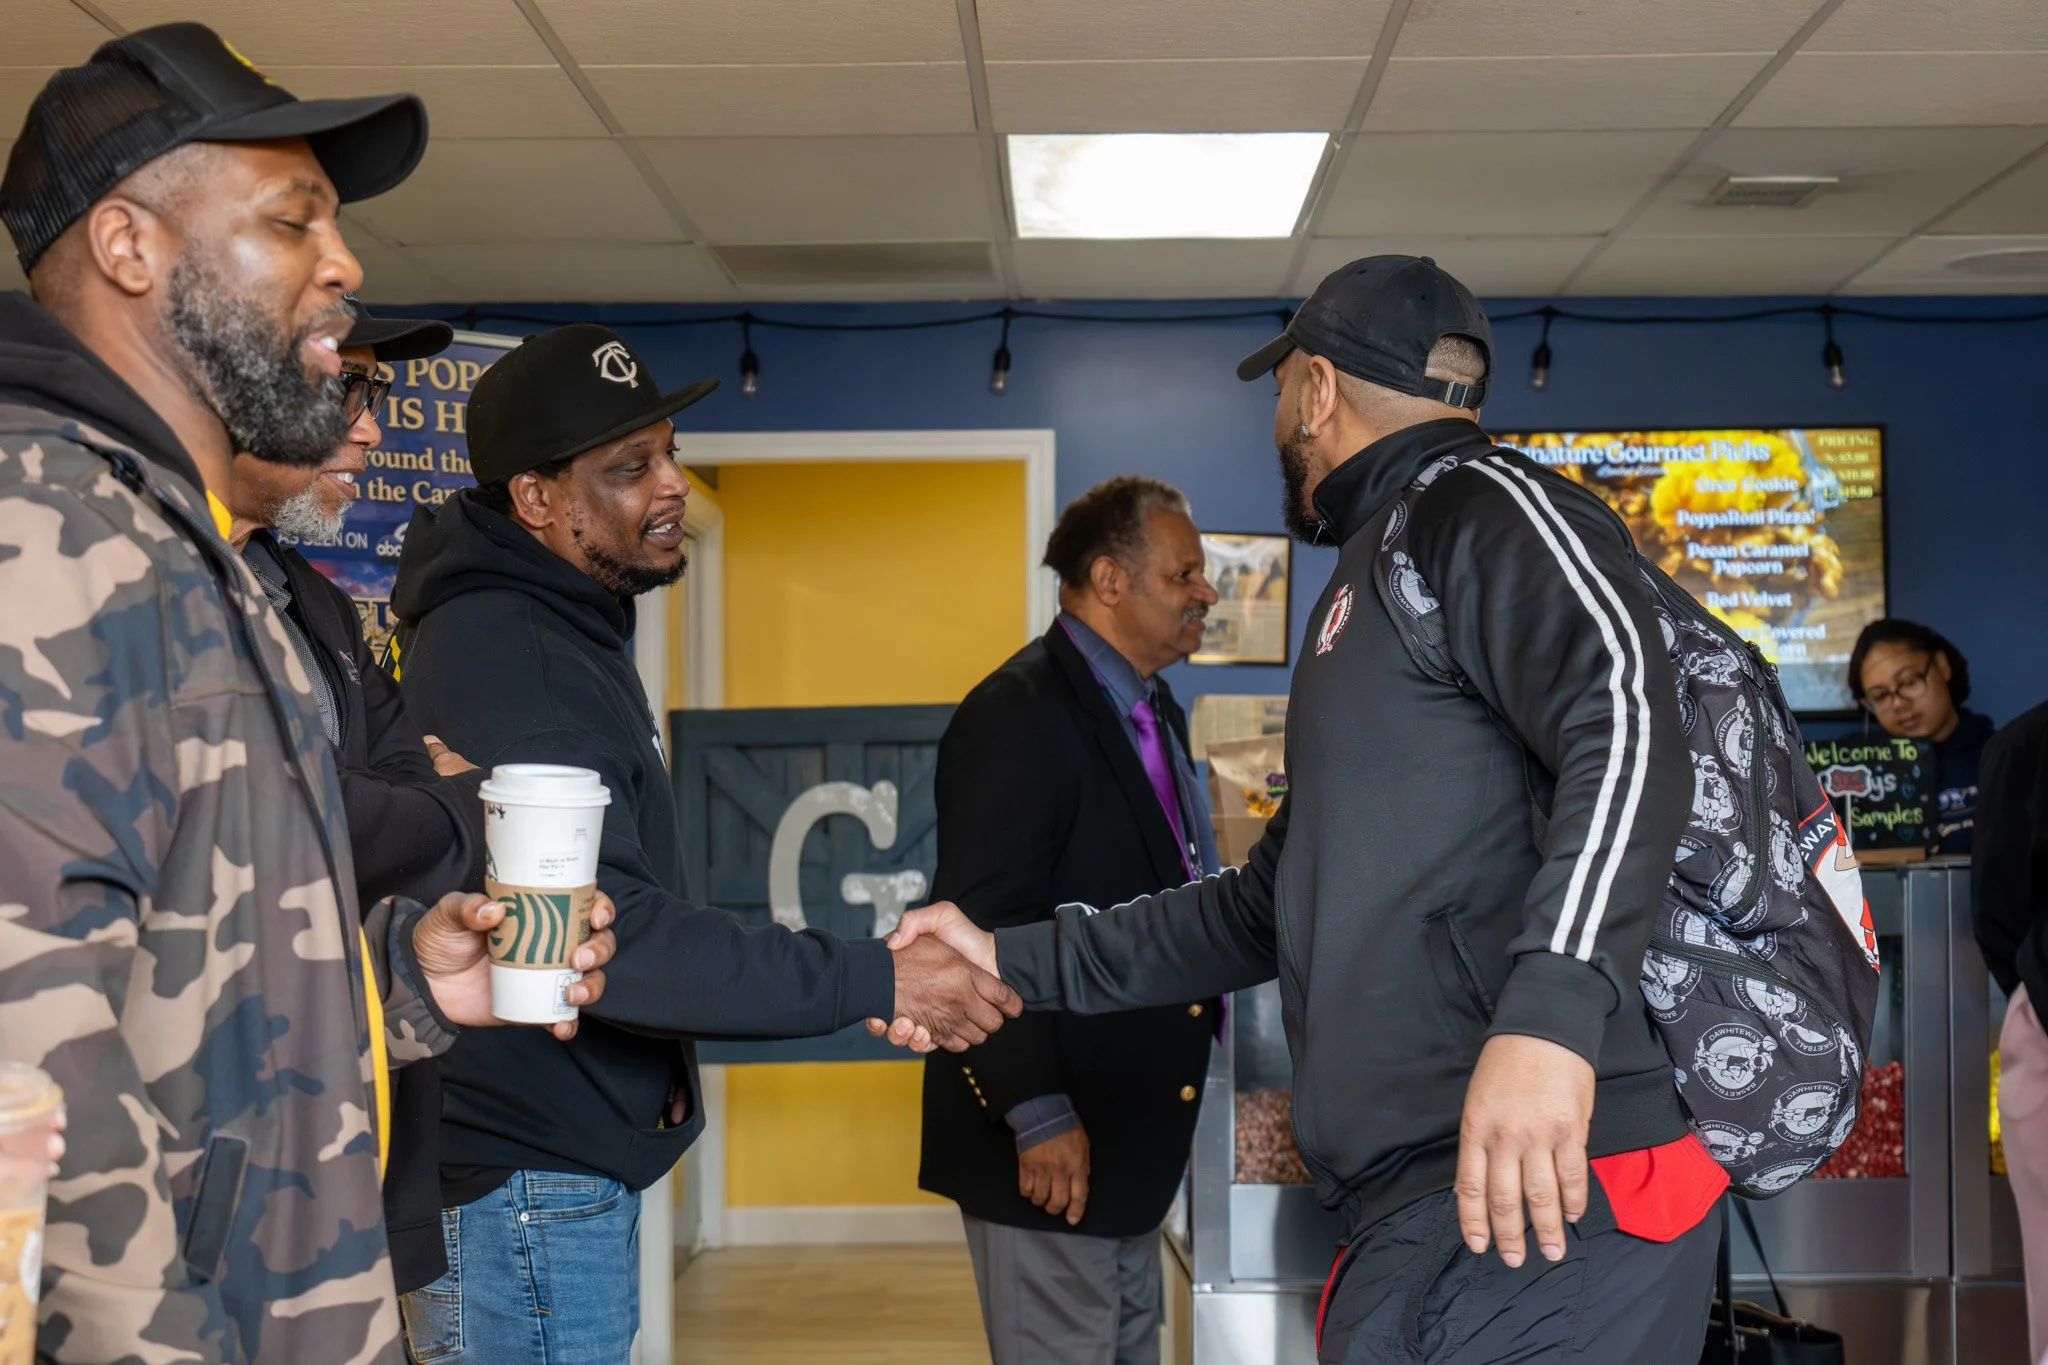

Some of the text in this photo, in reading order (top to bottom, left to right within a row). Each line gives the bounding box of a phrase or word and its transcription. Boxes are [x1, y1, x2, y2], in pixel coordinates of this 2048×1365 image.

[405, 358, 494, 392] POP
[386, 396, 425, 430] IS
[1605, 441, 1706, 464] Gourmet
[1710, 440, 1770, 461] Picks
[368, 476, 407, 499] the
[1741, 475, 1799, 492] Cookie
[346, 531, 368, 549] ON
[1687, 541, 1810, 559] Pecan Caramel
[1713, 558, 1785, 578] Popcorn
[1706, 591, 1793, 607] Red Velvet
[1891, 739, 1918, 761] To
[769, 780, 927, 938] G
[1708, 1027, 1762, 1042] DAWHITEWAY
[1707, 1078, 1757, 1097] BASKETBALL
[1786, 1084, 1838, 1100] DAWHITEWAY
